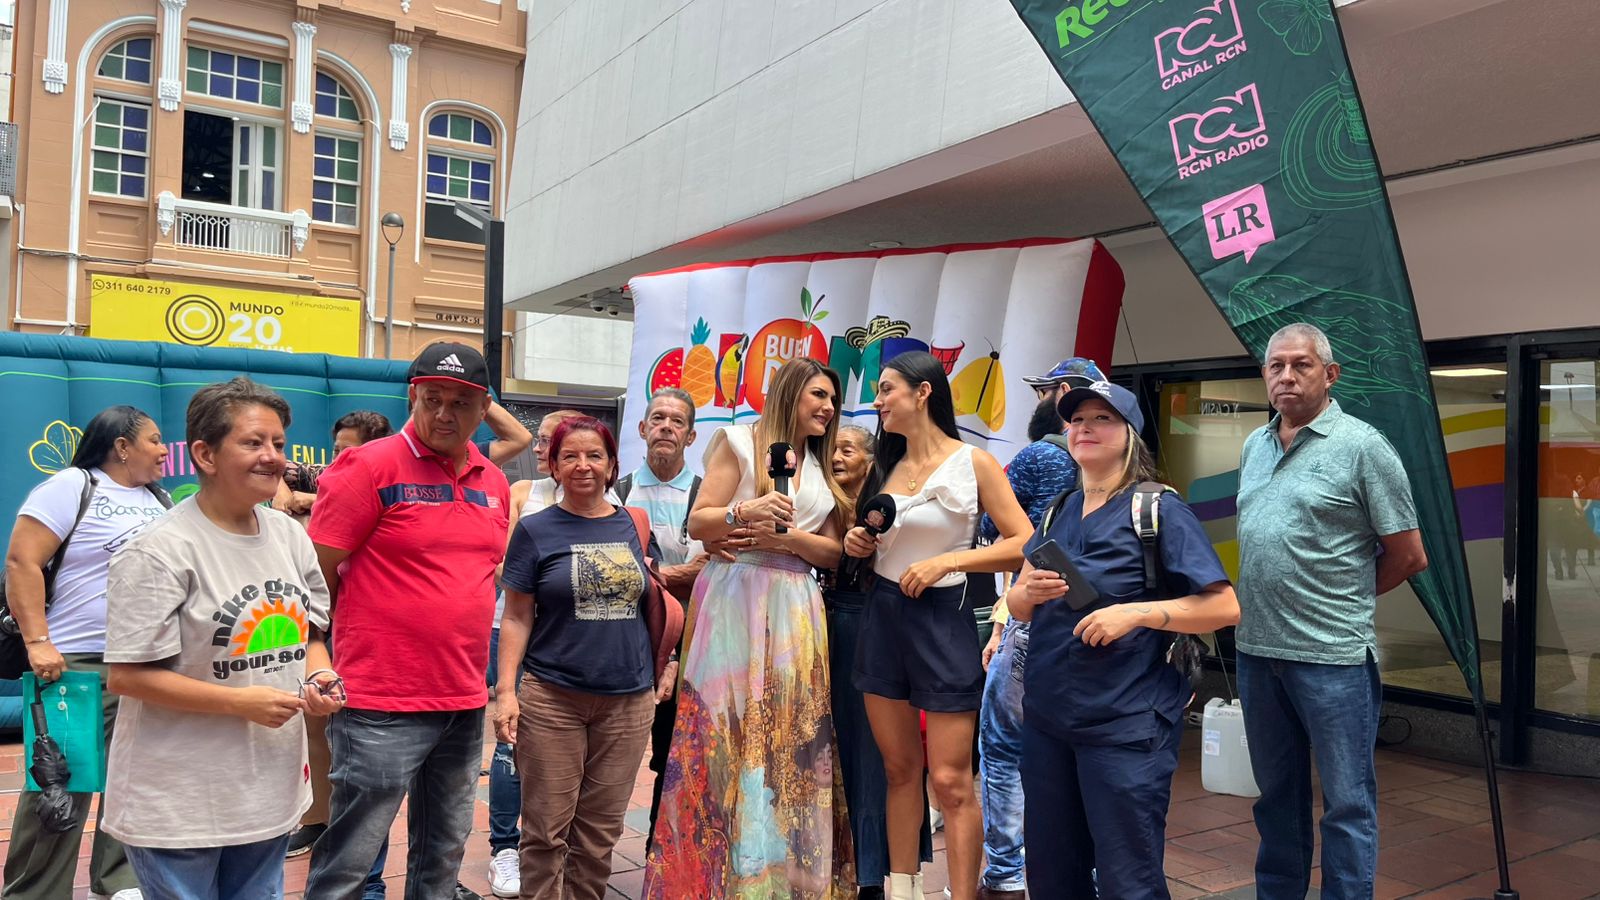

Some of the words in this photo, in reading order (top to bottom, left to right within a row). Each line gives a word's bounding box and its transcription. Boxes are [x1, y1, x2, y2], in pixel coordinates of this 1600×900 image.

[1161, 60, 1213, 91] CANAL
[1216, 40, 1248, 66] RCN
[1179, 156, 1213, 180] RCN
[1215, 134, 1269, 166] RADIO
[1211, 202, 1265, 243] LR
[105, 281, 123, 291] 311
[126, 284, 144, 293] 640
[147, 285, 171, 295] 2179
[230, 301, 284, 315] MUNDO
[228, 313, 282, 346] 20
[765, 334, 813, 359] BUEN
[436, 364, 465, 373] adidas
[212, 584, 259, 648] nike
[213, 654, 275, 680] your
[278, 648, 308, 664] so
